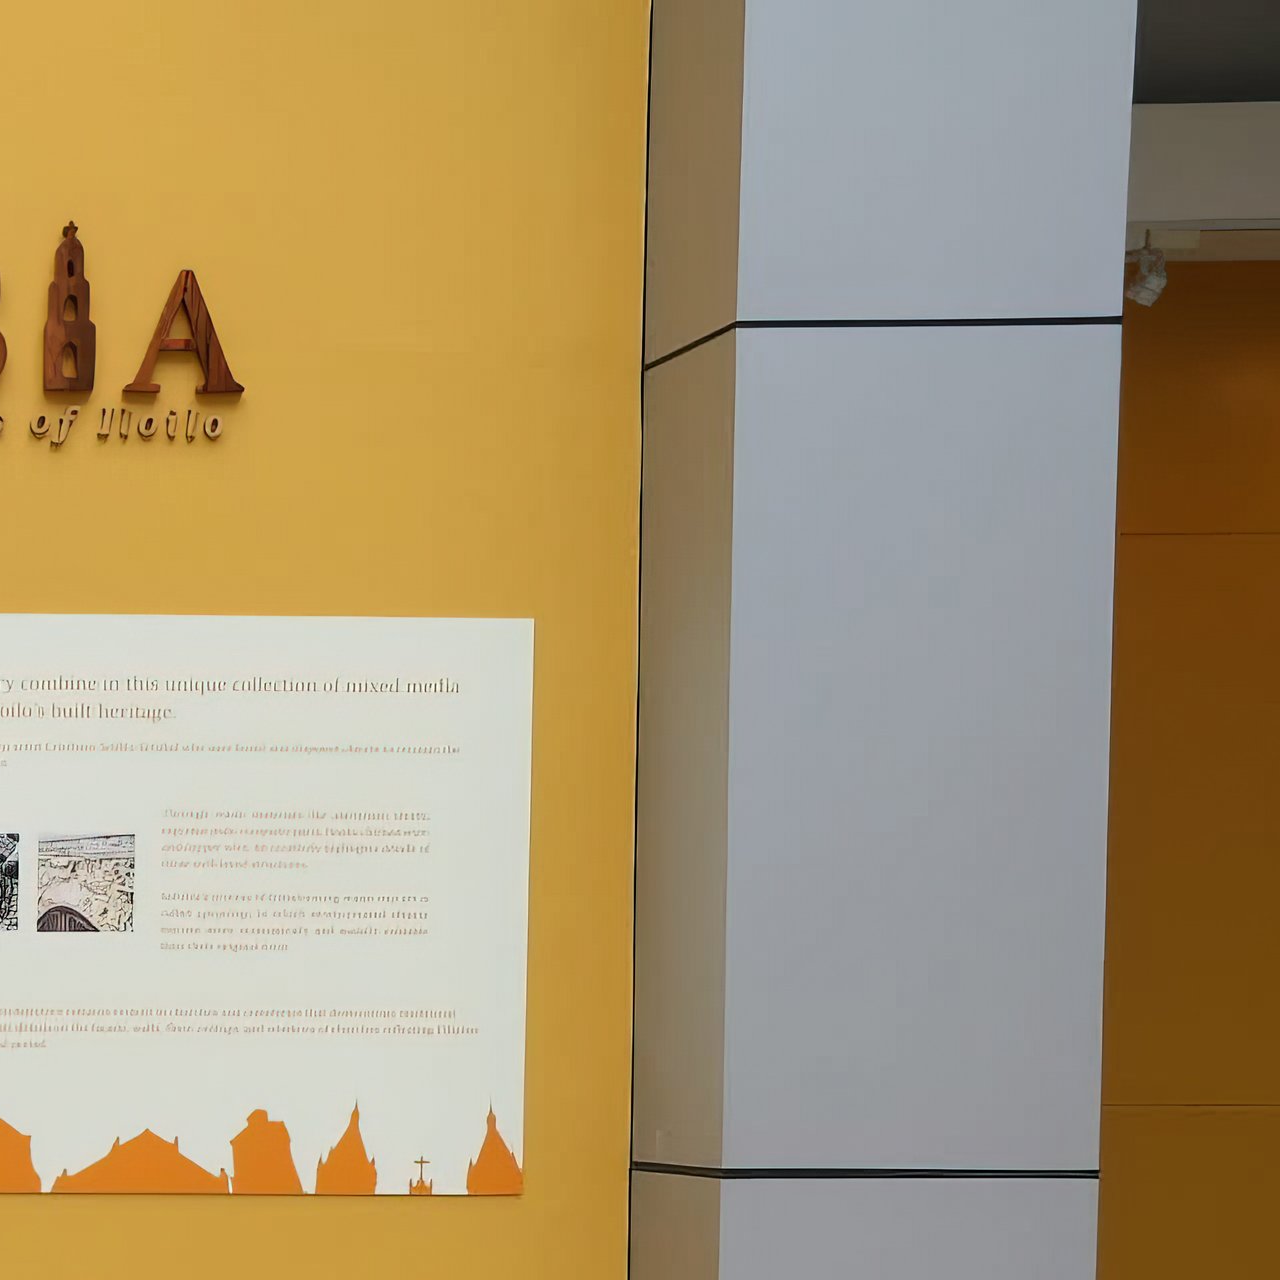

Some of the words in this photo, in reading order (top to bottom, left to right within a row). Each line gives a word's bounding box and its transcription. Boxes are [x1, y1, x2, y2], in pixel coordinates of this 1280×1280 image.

[29, 405, 81, 448] of
[96, 407, 225, 442] Iloilo
[103, 676, 120, 692] in
[126, 675, 159, 692] this
[165, 676, 227, 696] unique
[232, 676, 318, 693] collection
[323, 676, 340, 693] of
[346, 677, 400, 694] mixed
[406, 677, 460, 694] media
[51, 702, 92, 719] built
